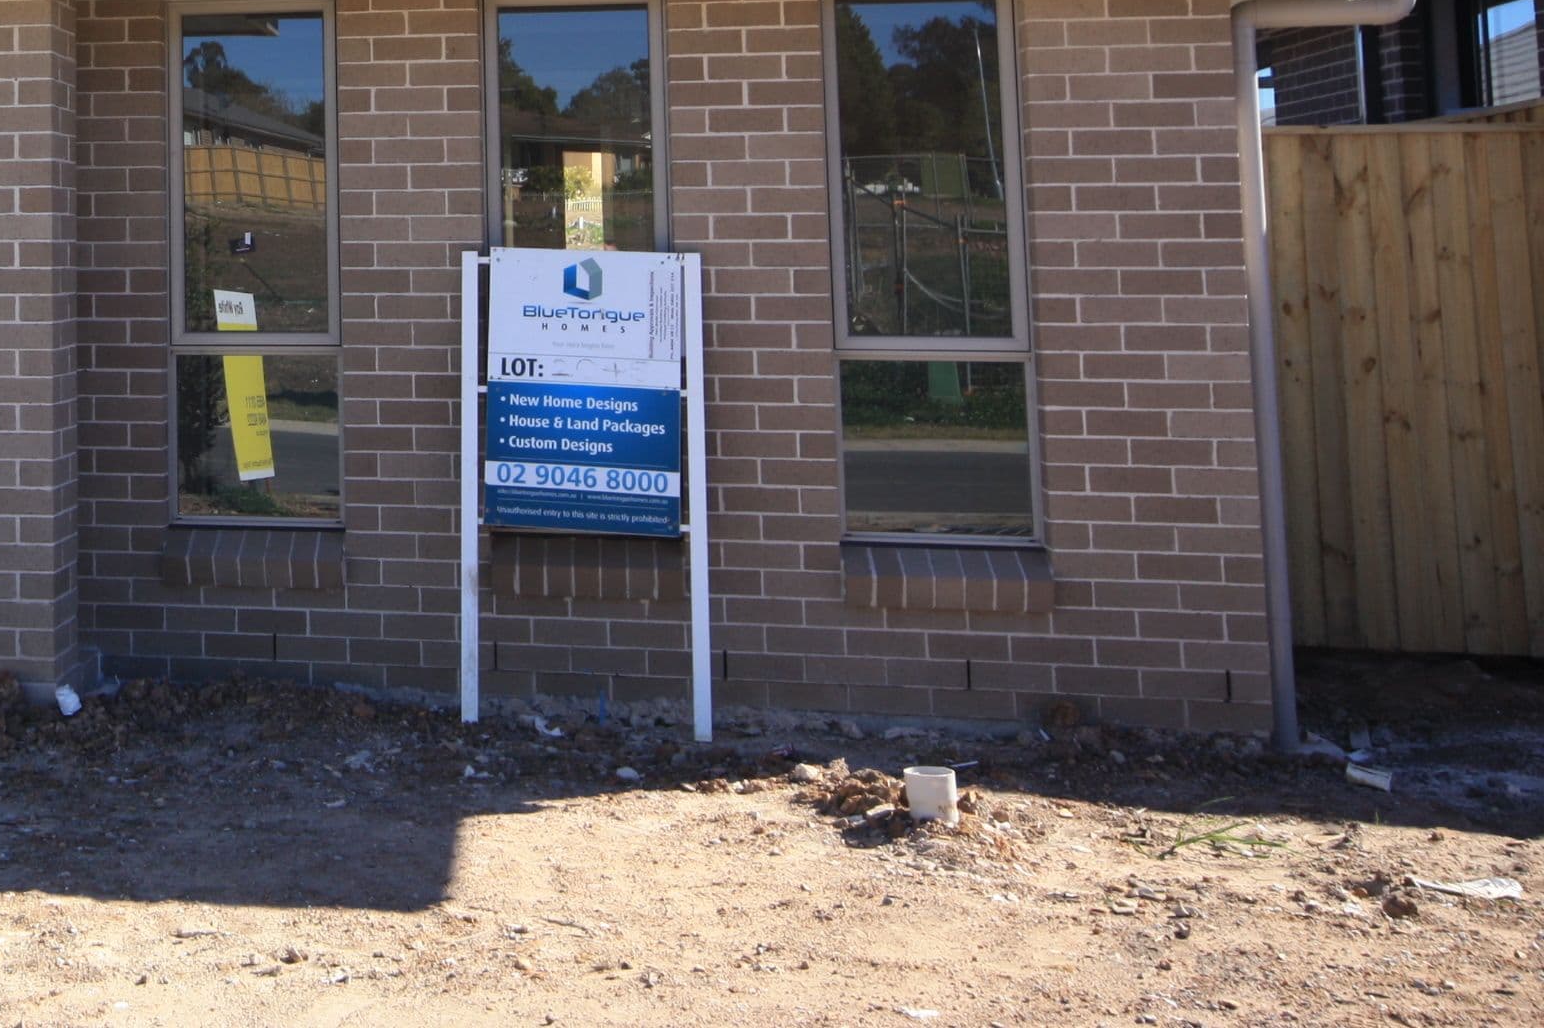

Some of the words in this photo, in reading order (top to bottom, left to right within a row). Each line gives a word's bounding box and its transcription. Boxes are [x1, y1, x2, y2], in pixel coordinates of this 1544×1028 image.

[522, 305, 646, 323] BlueTongue
[541, 323, 626, 334] HOMES
[501, 357, 544, 377] LOT:
[509, 393, 540, 407] New
[543, 395, 582, 409] Home
[586, 397, 639, 414] Designs
[509, 414, 550, 428] House
[553, 416, 563, 429] &
[567, 417, 599, 431] Land
[602, 419, 666, 437] Packages
[508, 435, 557, 450] Custom
[561, 438, 613, 455] Designs
[496, 463, 526, 484] 02
[535, 465, 598, 488] 9046
[606, 469, 669, 493] 8000
[496, 505, 542, 517] Unauthorised
[543, 508, 562, 519] entry
[563, 509, 571, 518] to
[571, 510, 585, 519] this
[586, 510, 599, 520] site
[600, 511, 606, 520] is
[607, 512, 630, 523] strictly
